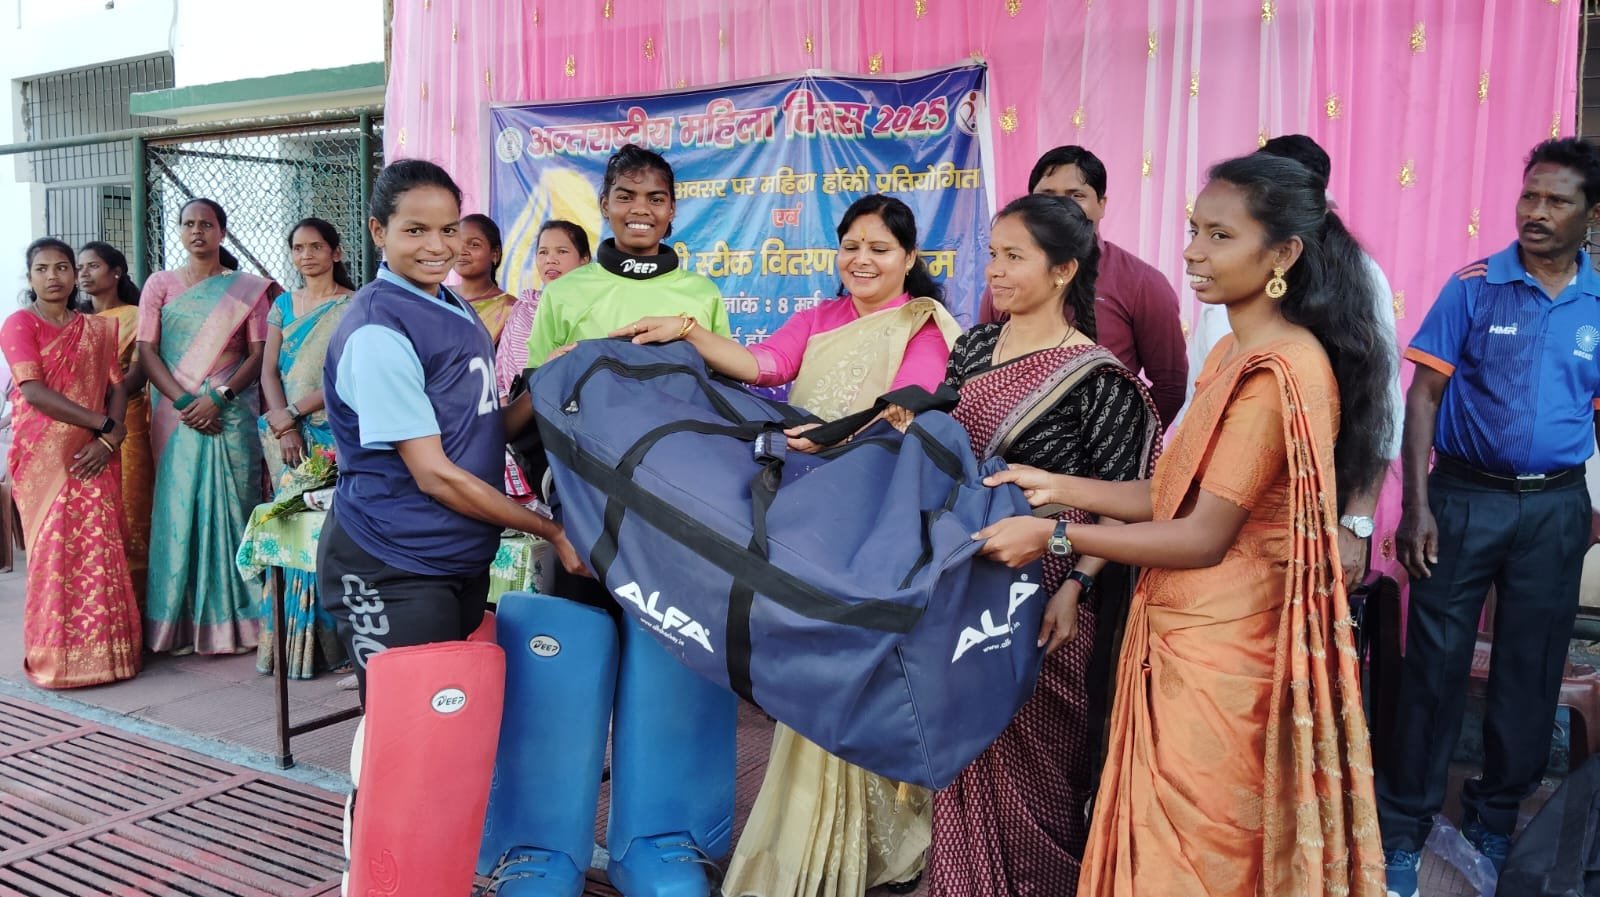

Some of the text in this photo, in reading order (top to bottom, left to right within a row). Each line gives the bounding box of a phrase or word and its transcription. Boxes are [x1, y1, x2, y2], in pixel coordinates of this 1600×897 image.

[679, 98, 777, 148] महिला
[783, 89, 873, 139] दिवस
[872, 96, 949, 138] 2025
[674, 178, 729, 200] अवसर
[730, 177, 758, 196] पर
[822, 164, 871, 194] हॉकी
[771, 201, 804, 228] एवं
[620, 258, 658, 274] DEEP
[696, 240, 755, 277] स्टीक
[761, 237, 839, 276] वितरण
[777, 298, 789, 314] 8
[614, 581, 714, 653] ALFA
[951, 581, 1040, 664] ALA
[532, 639, 559, 652] DEEP
[434, 695, 464, 707] DEEP
